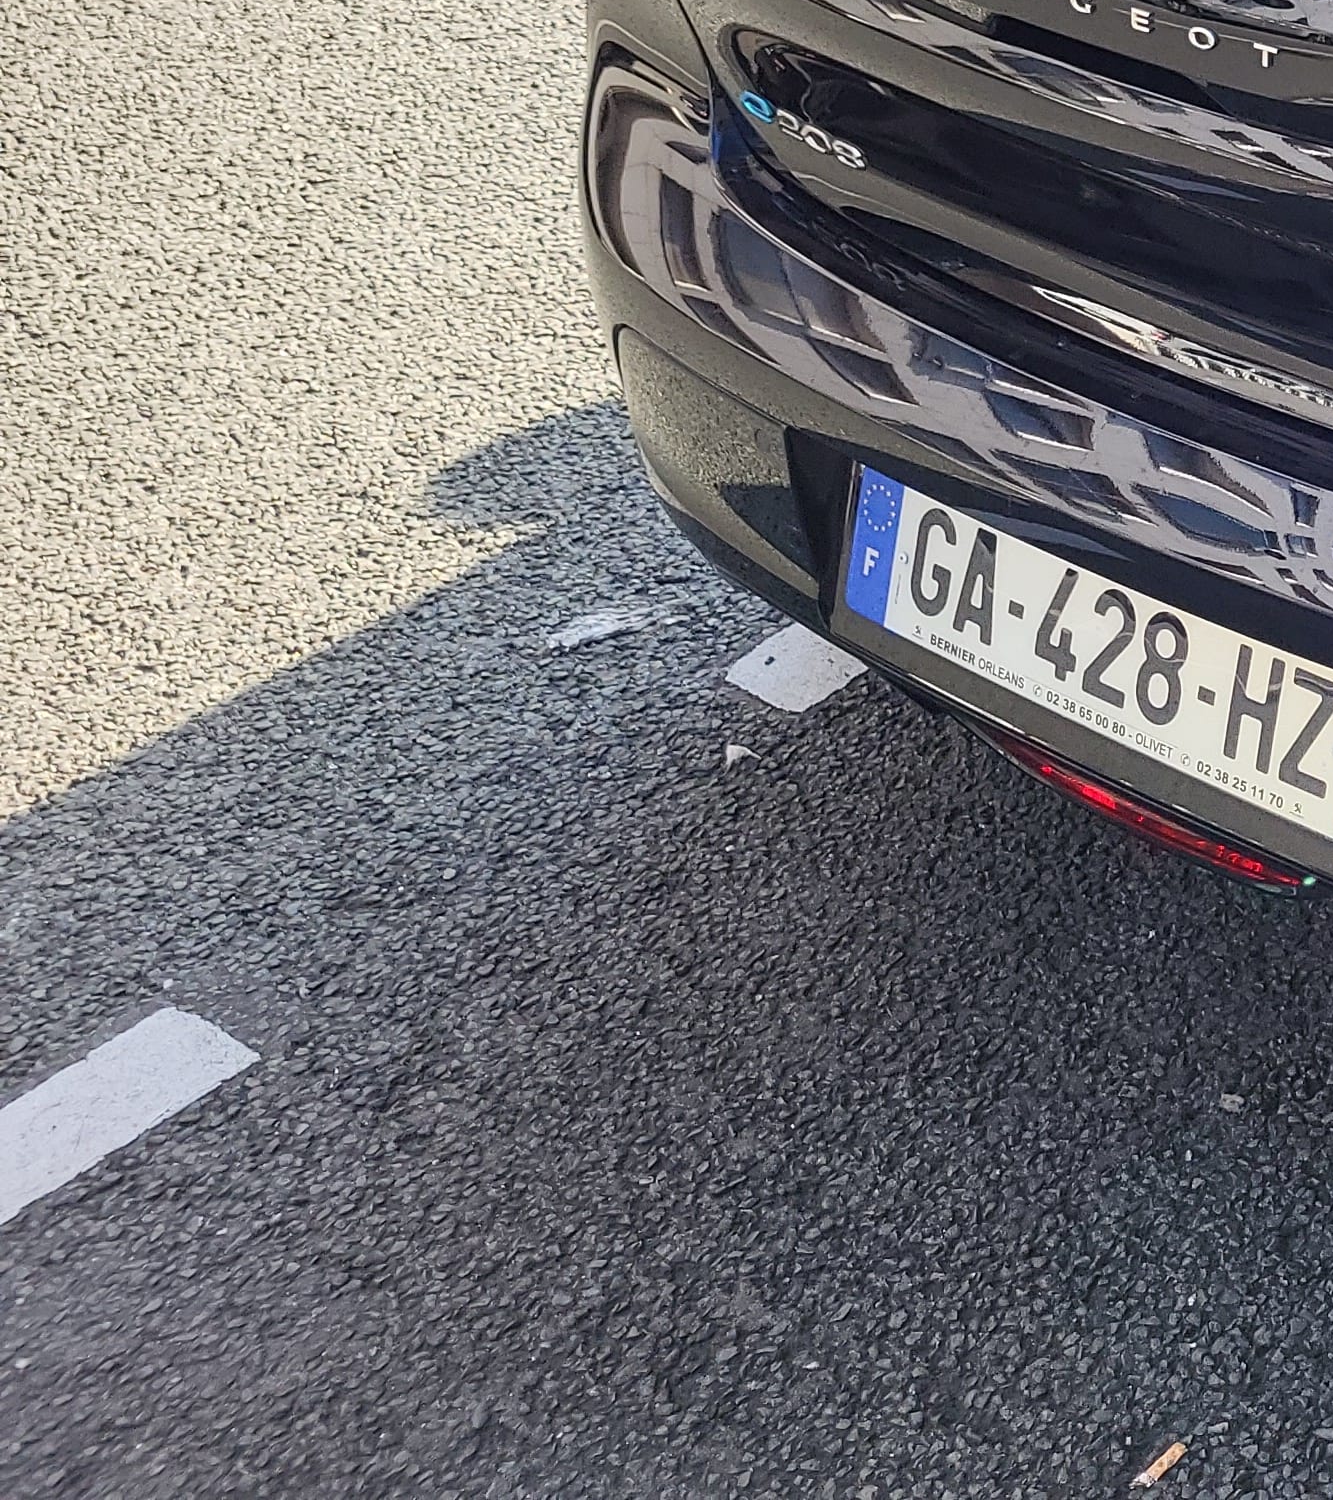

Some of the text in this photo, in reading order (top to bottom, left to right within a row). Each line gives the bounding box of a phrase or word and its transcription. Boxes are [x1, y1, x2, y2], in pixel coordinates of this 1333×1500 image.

[863, 546, 880, 577] F
[929, 633, 976, 666] BERNIER
[977, 656, 1025, 690] ORLEANS
[1046, 690, 1060, 707] 02
[1062, 698, 1077, 715] 38
[1078, 706, 1093, 722] 65
[1095, 713, 1110, 729] 00
[1111, 721, 1126, 737] 80
[1135, 732, 1174, 760] OLIVET
[1196, 760, 1212, 777] 02
[1214, 768, 1229, 785] 38
[1231, 776, 1247, 793] 25
[1251, 785, 1265, 801] 11
[1268, 792, 1284, 809] 70
